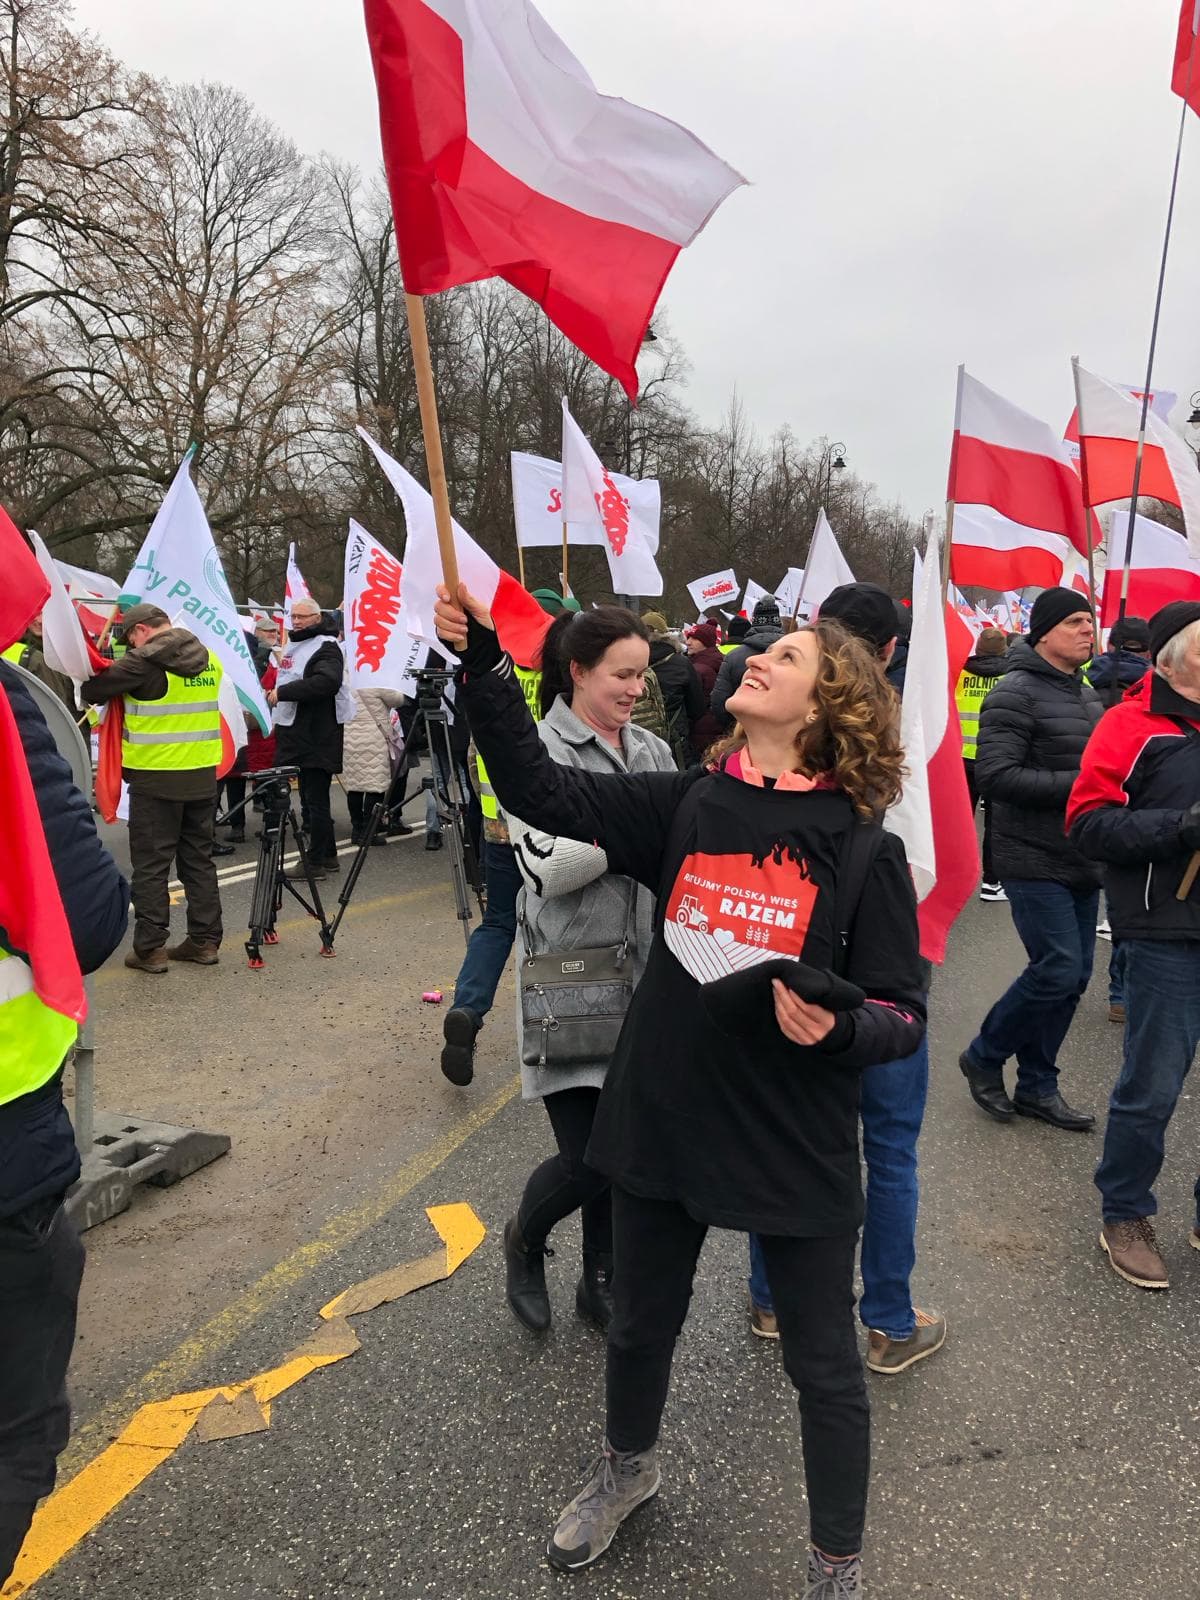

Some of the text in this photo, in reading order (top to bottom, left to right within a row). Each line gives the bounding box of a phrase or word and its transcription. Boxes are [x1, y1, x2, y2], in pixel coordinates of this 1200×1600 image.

[963, 676, 999, 689] ROLNIC
[724, 885, 766, 905] POLSKĄ
[770, 895, 798, 909] WIEŚ
[719, 898, 796, 930] RAZEM
